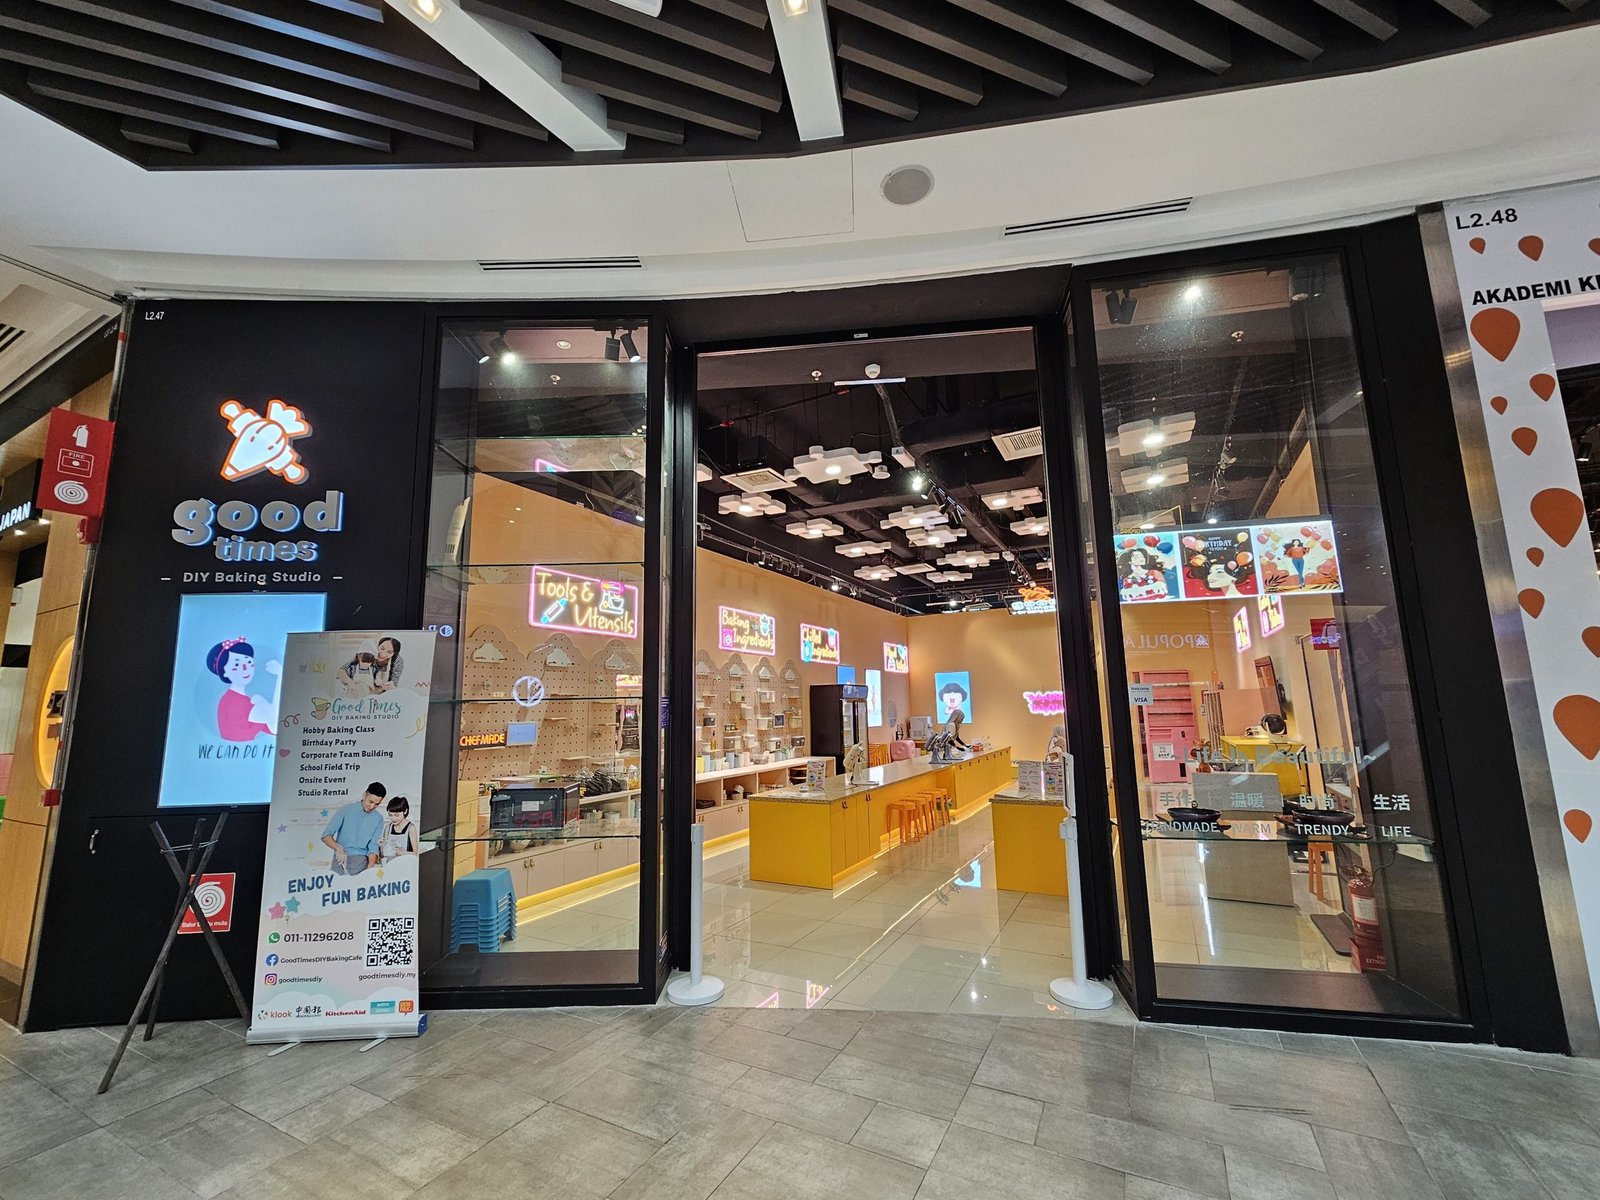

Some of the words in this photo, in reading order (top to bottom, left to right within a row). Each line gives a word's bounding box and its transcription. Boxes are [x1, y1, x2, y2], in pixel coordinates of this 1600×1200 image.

[1455, 208, 1518, 230] L2.48
[1472, 279, 1572, 305] AKADEMI
[144, 311, 165, 321] L2.47
[68, 451, 86, 460] FIRE
[171, 490, 345, 546] good
[213, 534, 320, 562] times
[183, 572, 211, 584] DIY
[214, 572, 268, 586] Baking
[272, 571, 322, 584] Studio
[536, 572, 577, 602] Tools
[581, 581, 595, 602] &
[574, 604, 635, 636] Utensils
[722, 609, 750, 635] Baking
[332, 697, 365, 715] Good
[367, 697, 401, 715] Times
[373, 713, 400, 721] STUDIO
[302, 726, 325, 735] Hobby
[326, 726, 354, 735] Baking
[355, 725, 375, 733] Class
[301, 739, 333, 748] Birthday
[334, 738, 357, 747] Party
[459, 732, 506, 748] CHEFMADE
[300, 752, 338, 760] Corporate
[361, 750, 394, 759] Building
[299, 763, 323, 772] School
[324, 763, 343, 771] Field
[344, 763, 361, 772] Trip
[299, 776, 323, 784] Onsite
[323, 776, 346, 784] Event
[298, 789, 322, 797] Studio
[322, 788, 349, 796] Rental
[1230, 792, 1265, 809] 温暖
[1372, 793, 1411, 811] 生活
[1231, 823, 1271, 834] WARM
[1294, 823, 1350, 836] TRENDY
[1381, 825, 1412, 838] LIFE
[287, 874, 335, 893] ENJOY
[321, 889, 351, 907] FUN
[356, 880, 411, 902] BAKING
[284, 931, 354, 943] 011-11296208
[280, 955, 363, 964] GoodTimesDIYBakingCafe
[278, 975, 323, 985] goodtimesdiy
[358, 972, 416, 981] goodtimesdiy.my
[270, 1010, 292, 1018] klook
